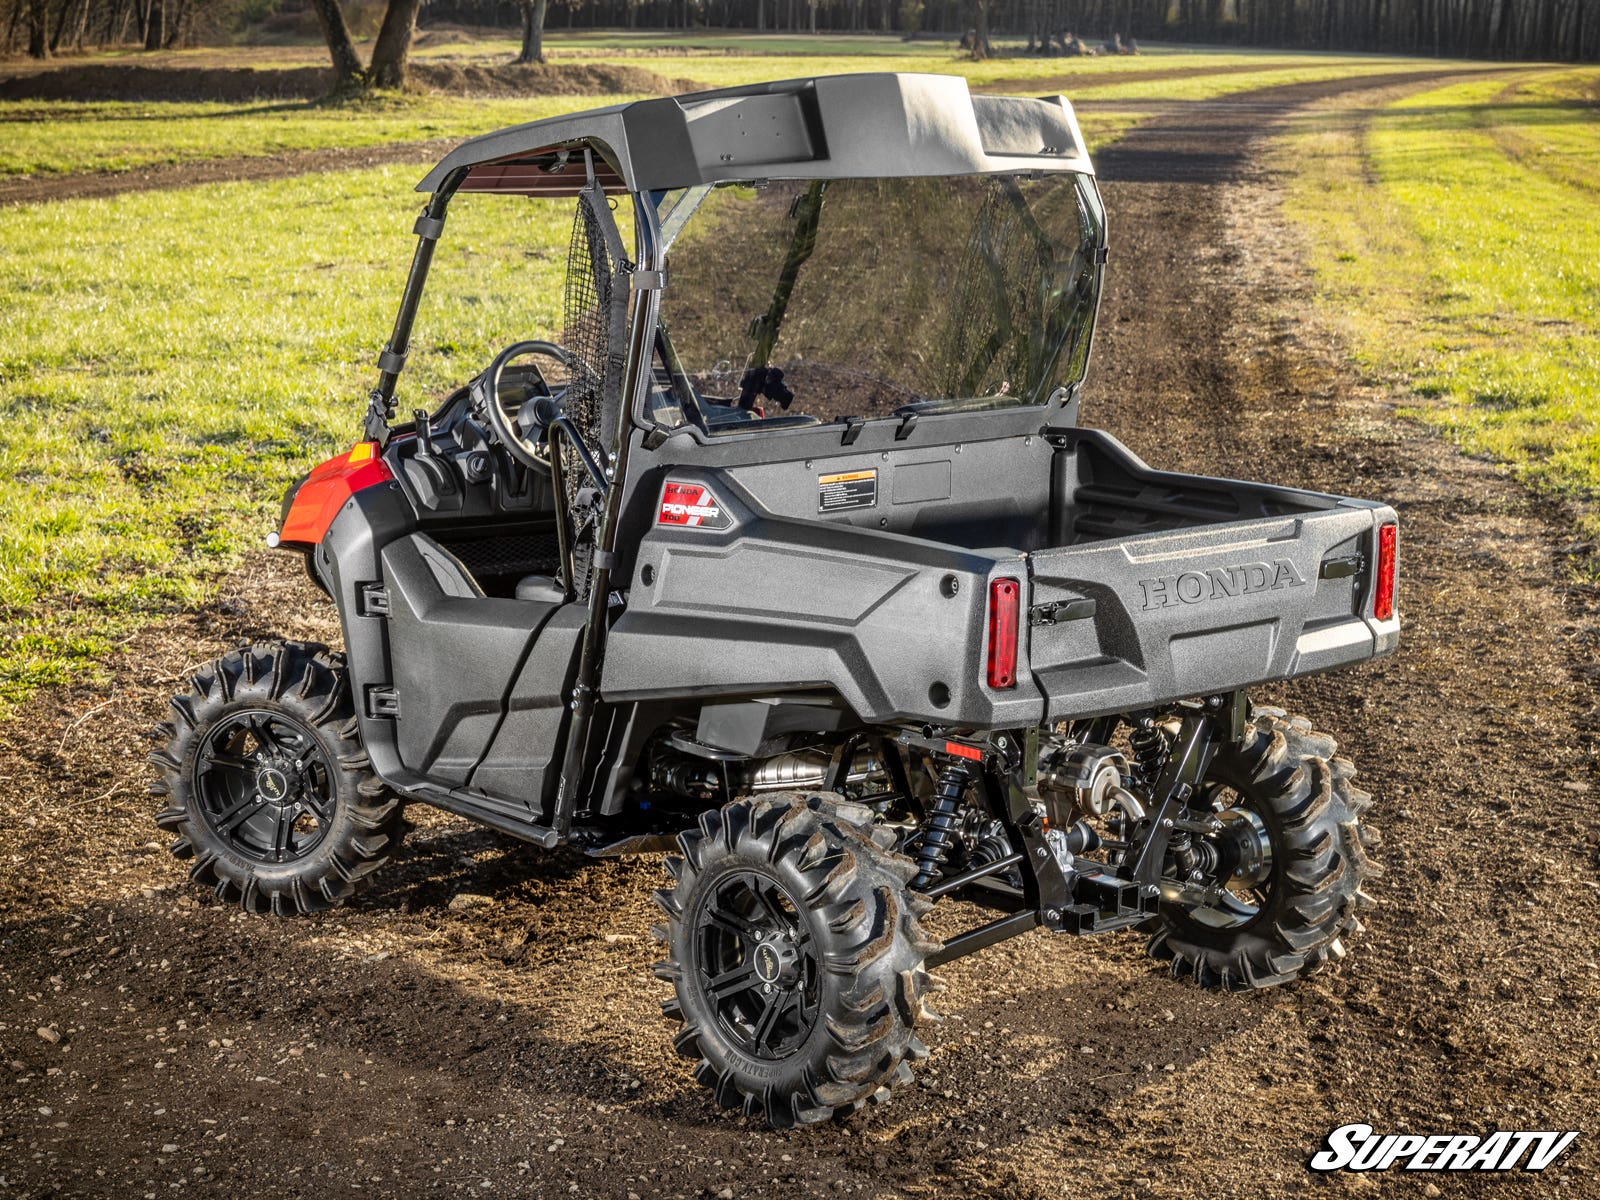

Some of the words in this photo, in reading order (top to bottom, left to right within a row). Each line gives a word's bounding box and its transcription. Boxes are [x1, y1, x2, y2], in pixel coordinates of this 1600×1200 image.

[667, 487, 699, 496] HONDA
[662, 503, 720, 518] PIONEER
[1139, 558, 1306, 611] HONDA
